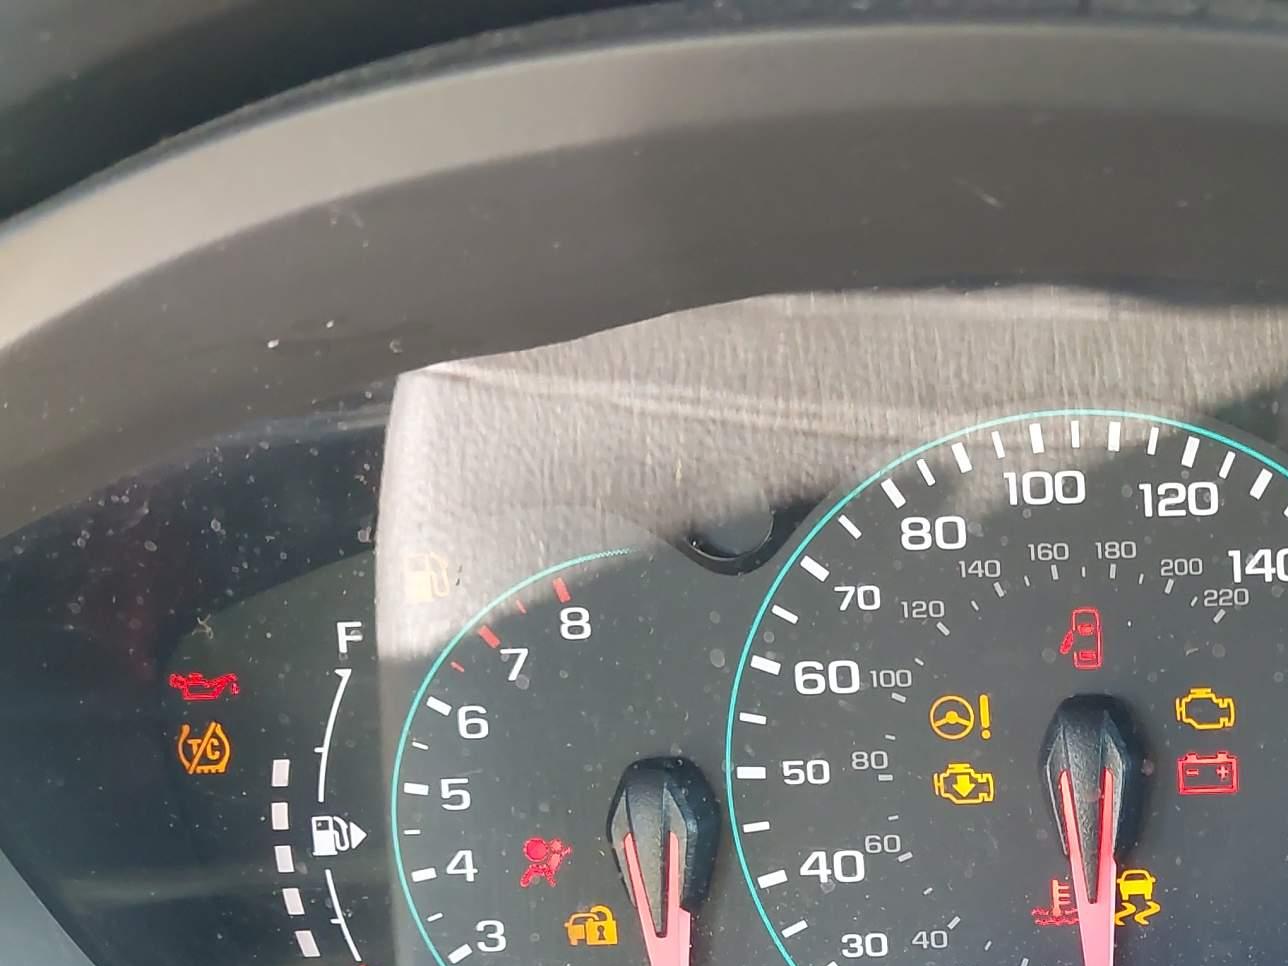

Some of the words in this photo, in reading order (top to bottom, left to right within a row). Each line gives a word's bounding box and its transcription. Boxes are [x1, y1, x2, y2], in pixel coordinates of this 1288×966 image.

[1003, 470, 1086, 506] 100
[1138, 481, 1219, 517] 120
[900, 515, 967, 551] 80
[1027, 542, 1070, 561] 160
[1095, 540, 1137, 560] 180
[958, 559, 1001, 578] 140
[1160, 557, 1203, 577] 200
[834, 585, 881, 611] 70
[900, 600, 945, 619] 120
[1203, 588, 1250, 607] 220
[560, 606, 592, 640] 8
[336, 621, 363, 654] F
[499, 648, 529, 681] 7
[794, 660, 860, 695] 60
[869, 669, 912, 688] 100
[457, 705, 489, 739] 6
[782, 759, 831, 785] 50
[851, 750, 889, 770] 80
[440, 778, 471, 811] 5
[864, 834, 901, 854] 60
[446, 849, 478, 882] 4
[799, 849, 865, 884] 40
[475, 919, 507, 952] 3
[841, 932, 889, 958] 30
[911, 930, 948, 949] 40
